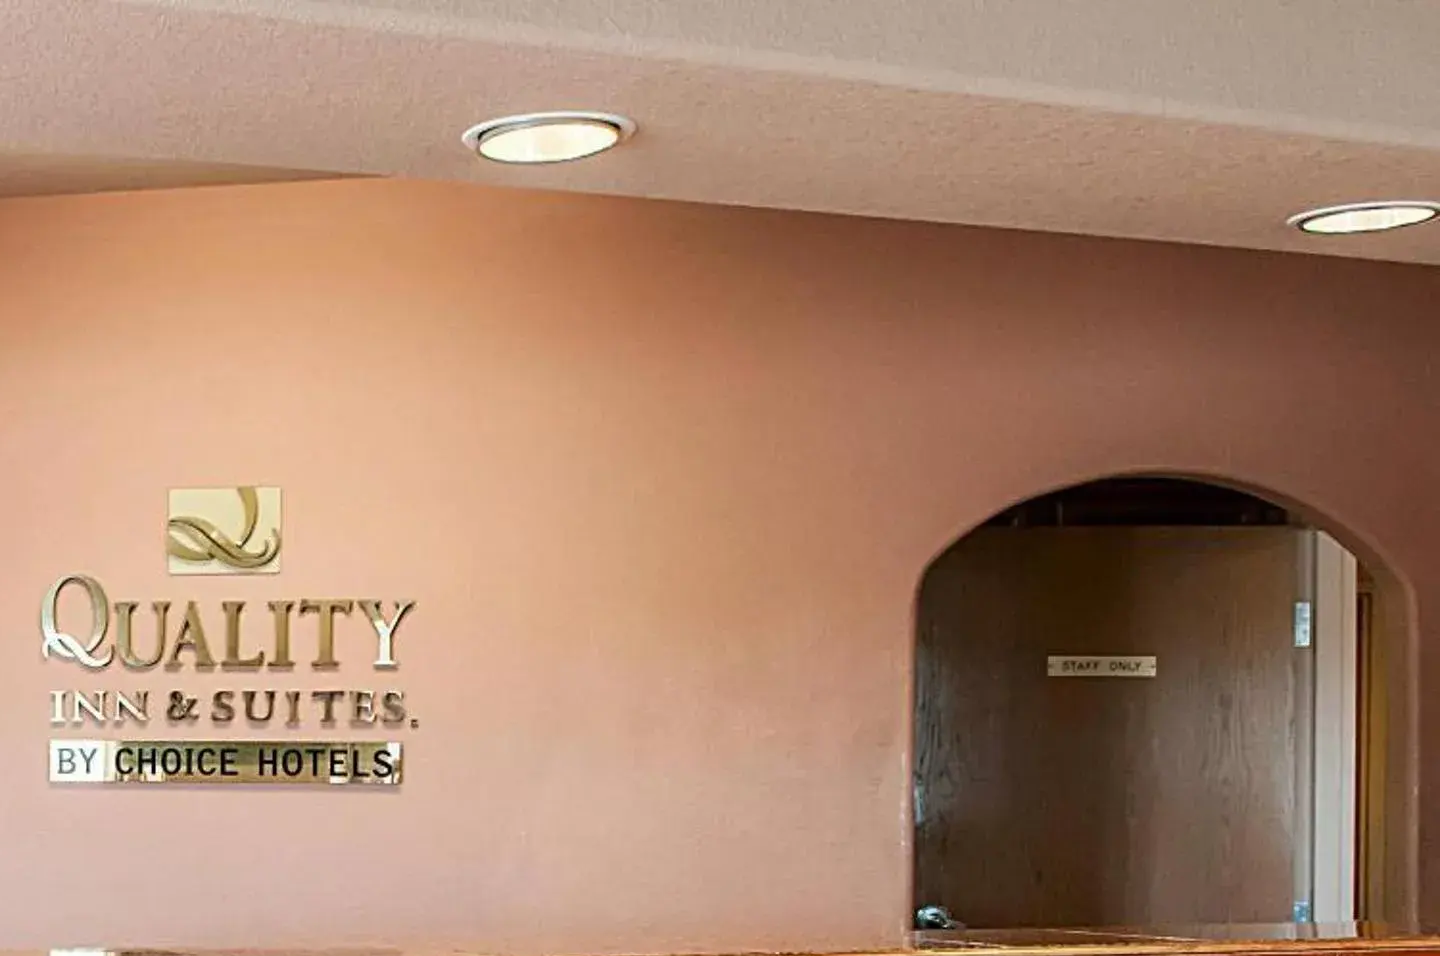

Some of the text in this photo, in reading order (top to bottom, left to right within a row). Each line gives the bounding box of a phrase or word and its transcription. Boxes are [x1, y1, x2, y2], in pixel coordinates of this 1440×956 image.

[41, 574, 416, 668] QUALITY
[1109, 661, 1142, 672] ONLY
[50, 689, 149, 724] INN
[166, 689, 200, 722] &
[57, 748, 393, 778] BY CHOICE HOTELS
